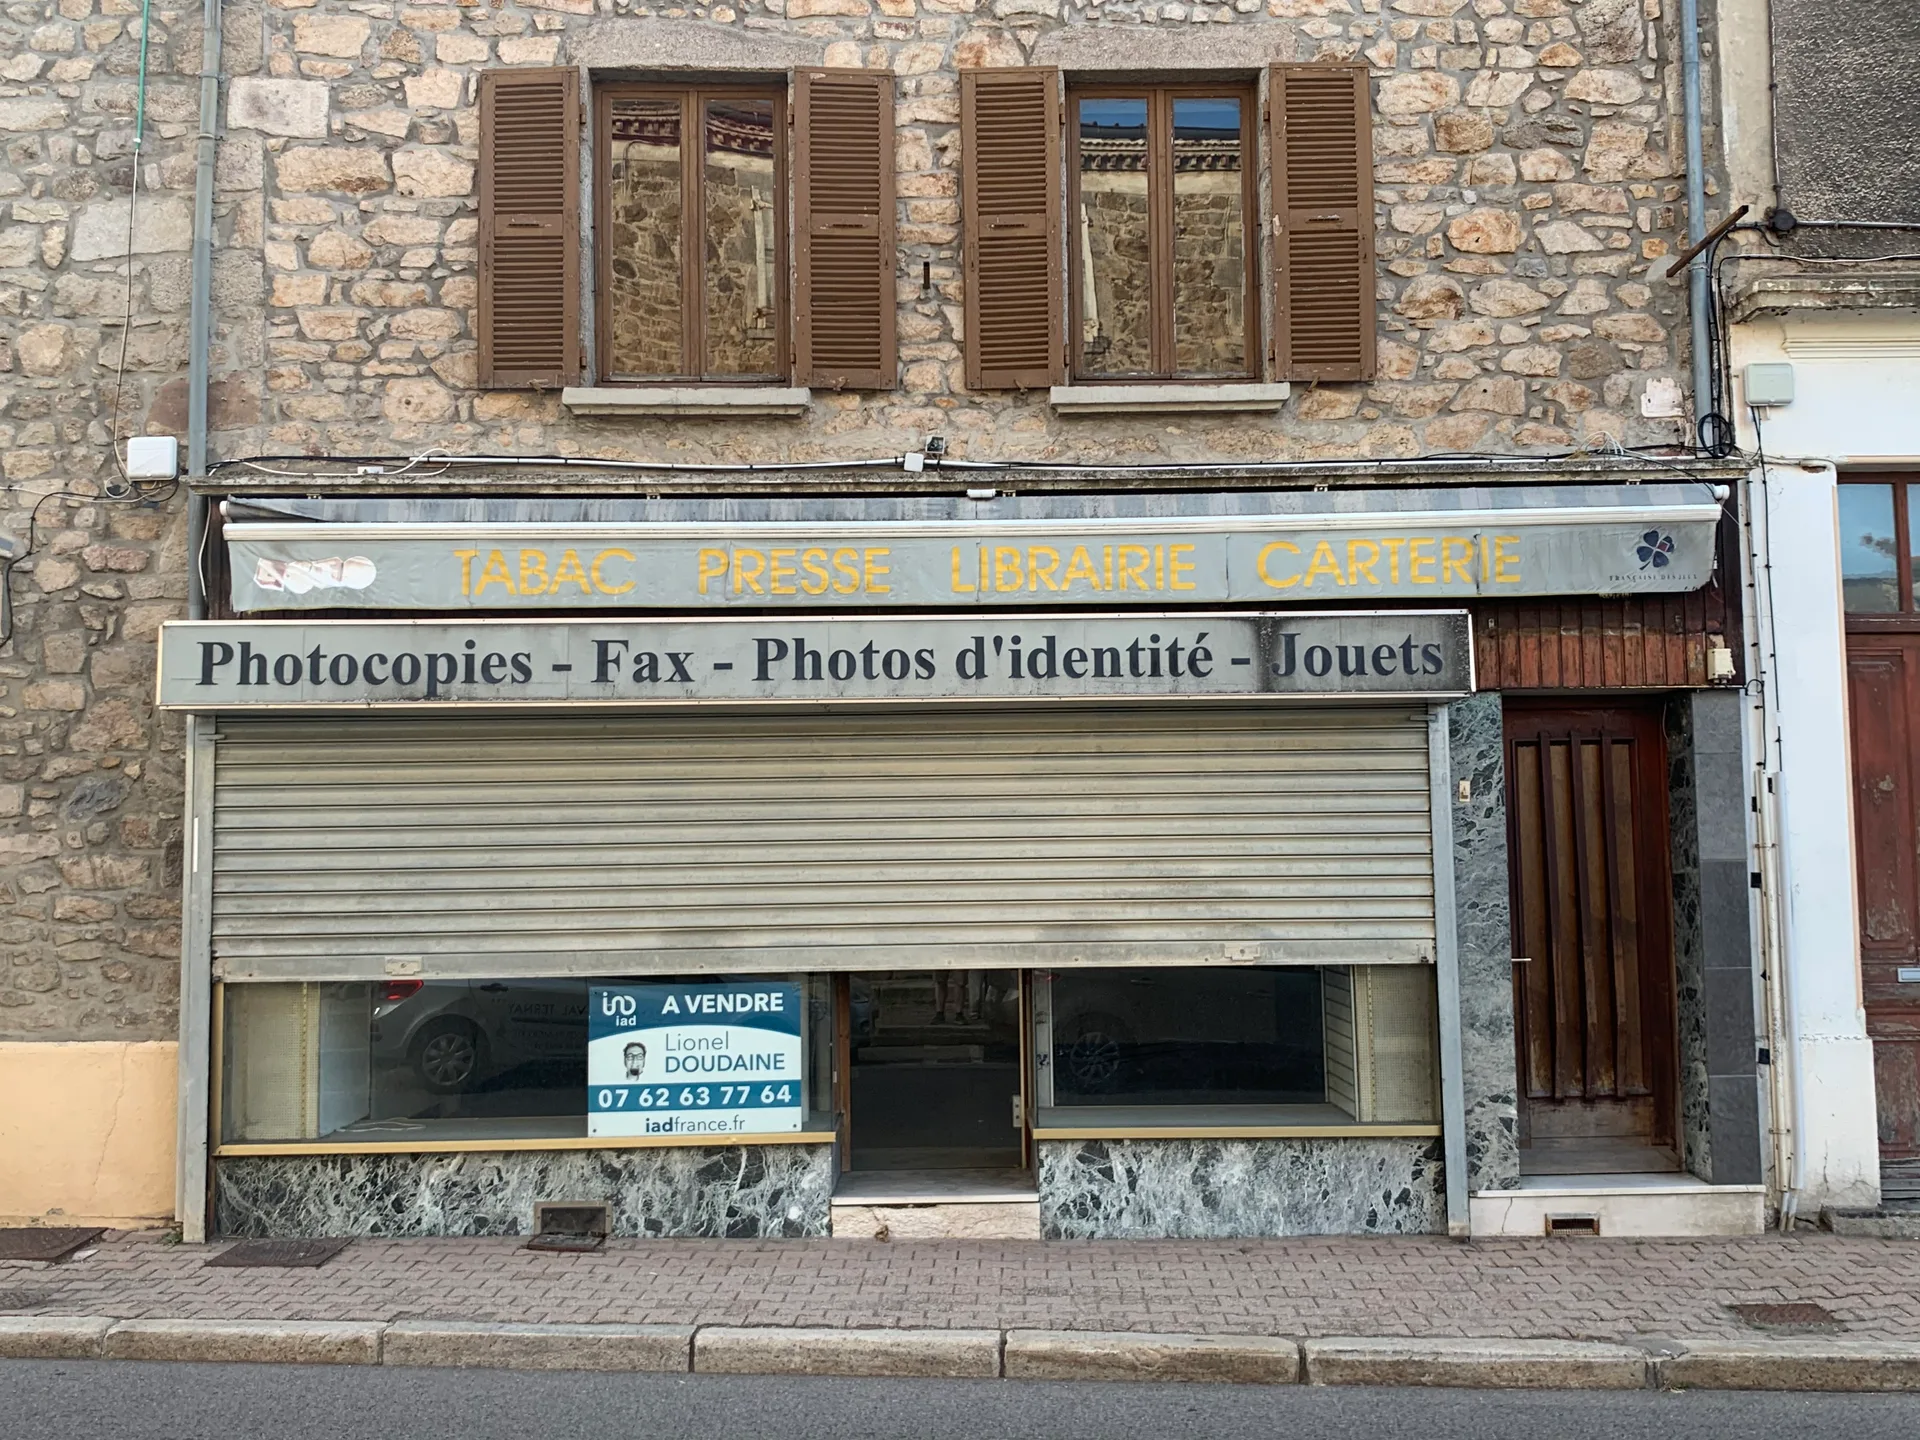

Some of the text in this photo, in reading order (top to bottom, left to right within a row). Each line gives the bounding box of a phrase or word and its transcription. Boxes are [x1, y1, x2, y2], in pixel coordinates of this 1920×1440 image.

[454, 535, 1520, 596] TABAC PRESSE LIBRAIRIE CARTERIE
[197, 631, 1444, 698] Photocopies - Fax - Photos d'identité - Jouets
[661, 995, 681, 1015] A
[684, 992, 784, 1014] VENDRE
[615, 1015, 637, 1026] iad
[665, 1031, 729, 1052] Lionel
[665, 1053, 786, 1073] DOUDAINE
[598, 1084, 792, 1108] 07 62 63 77 64
[645, 1115, 746, 1133] iadfrance.fr
